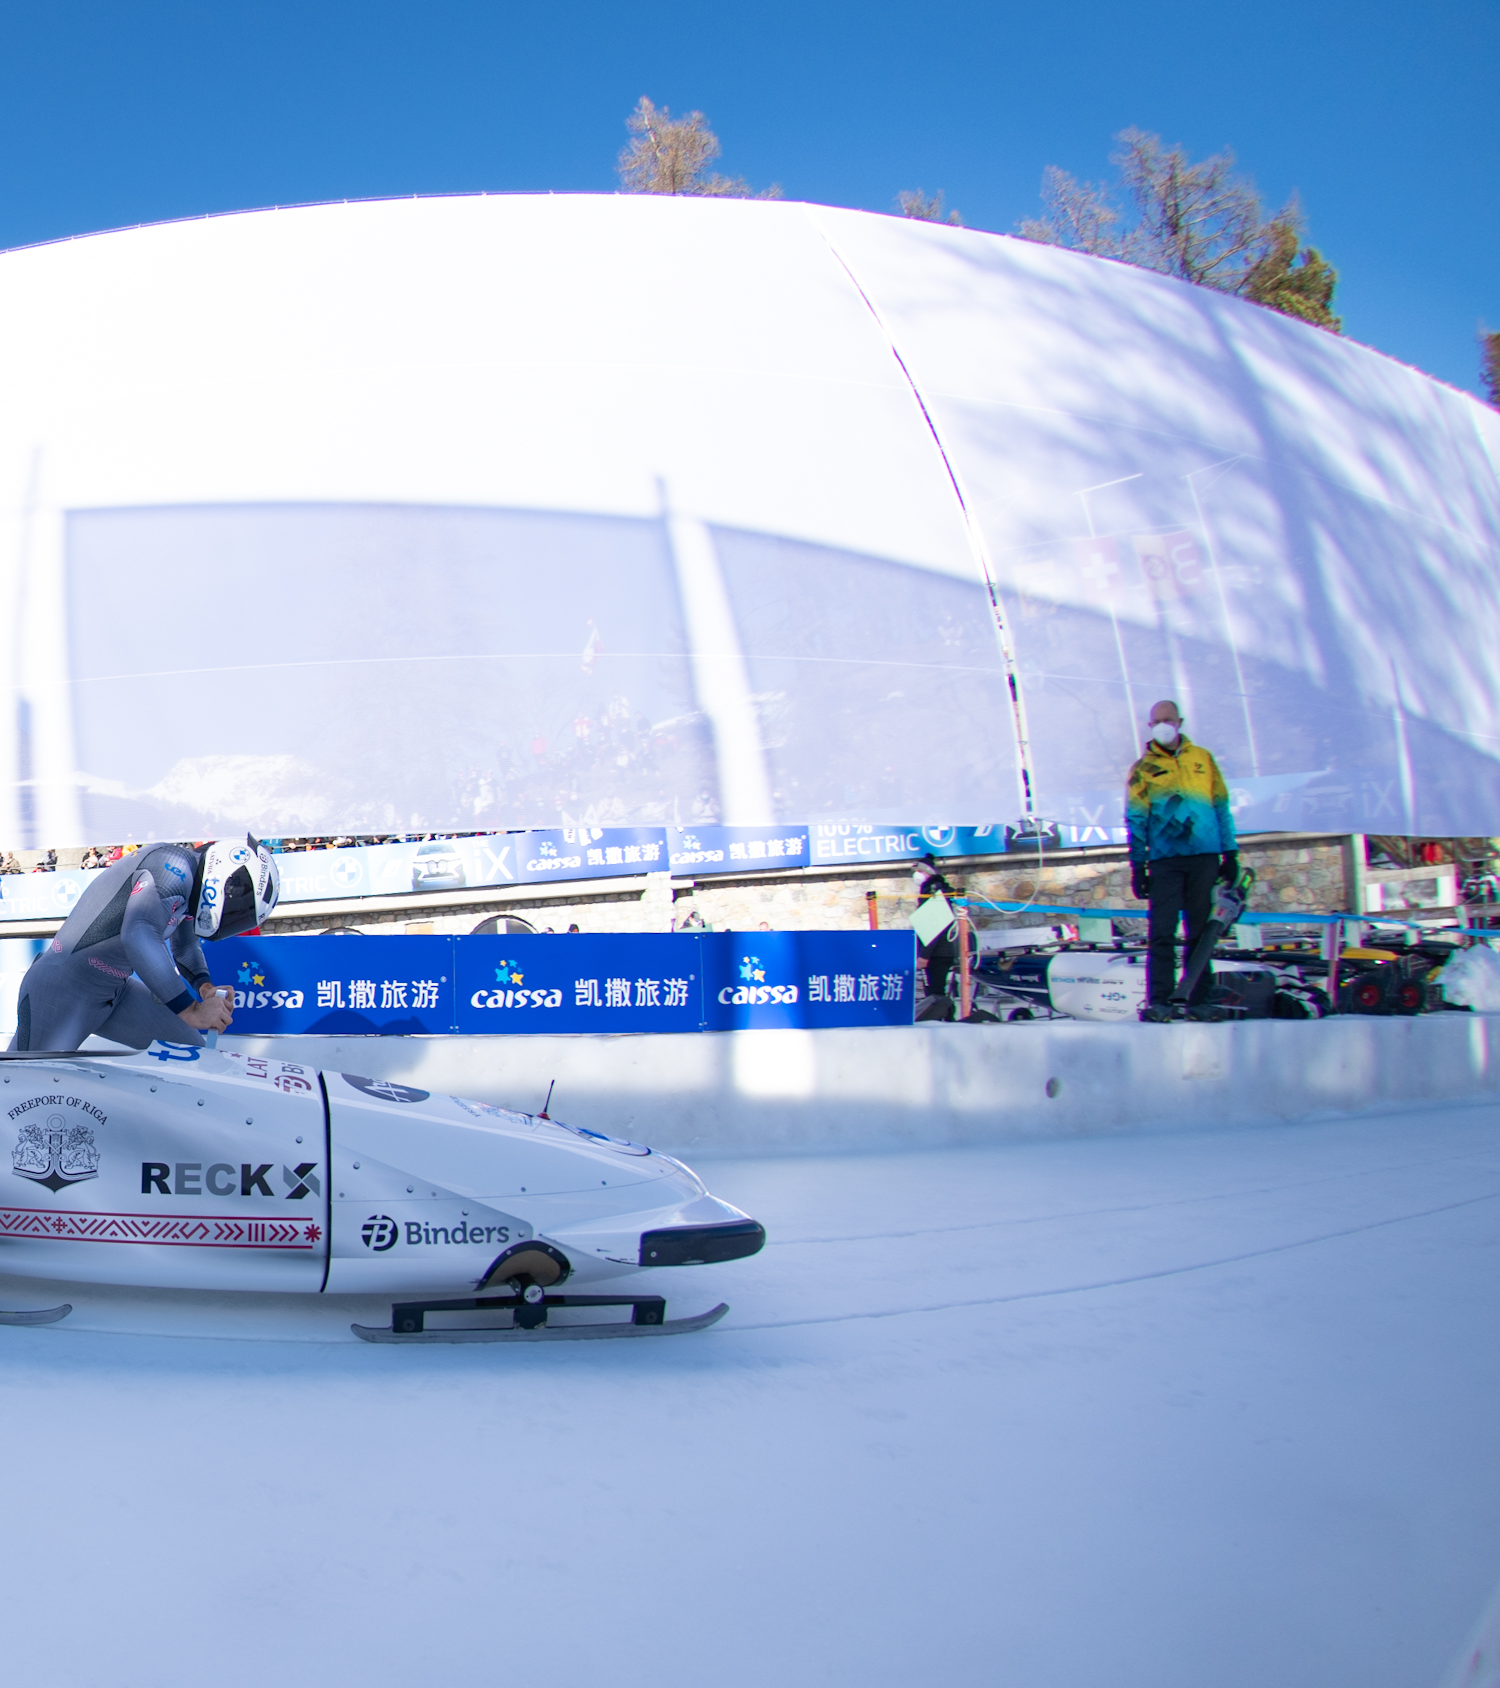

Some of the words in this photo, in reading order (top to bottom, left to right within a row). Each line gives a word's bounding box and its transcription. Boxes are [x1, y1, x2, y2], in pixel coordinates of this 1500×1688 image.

[586, 843, 660, 866] 凯撒旅游
[669, 849, 724, 865] caissa
[728, 837, 803, 861] 凯撒旅游
[817, 833, 920, 858] ELECTRIC
[474, 846, 514, 882] iX
[526, 854, 581, 872] caissa
[256, 864, 268, 896] Binders
[200, 878, 220, 909] tet
[231, 989, 305, 1010] aissa
[316, 979, 440, 1009] 凯撒旅游
[470, 989, 563, 1009] caissa
[574, 978, 689, 1008] 凯撒旅游
[717, 984, 798, 1006] caissa
[808, 974, 904, 1003] 凯撒旅游
[7, 1095, 63, 1121] FREEPORT
[65, 1096, 81, 1108] OF
[81, 1101, 108, 1126] RIGA
[141, 1162, 275, 1197] RECK
[404, 1221, 510, 1246] Binders
